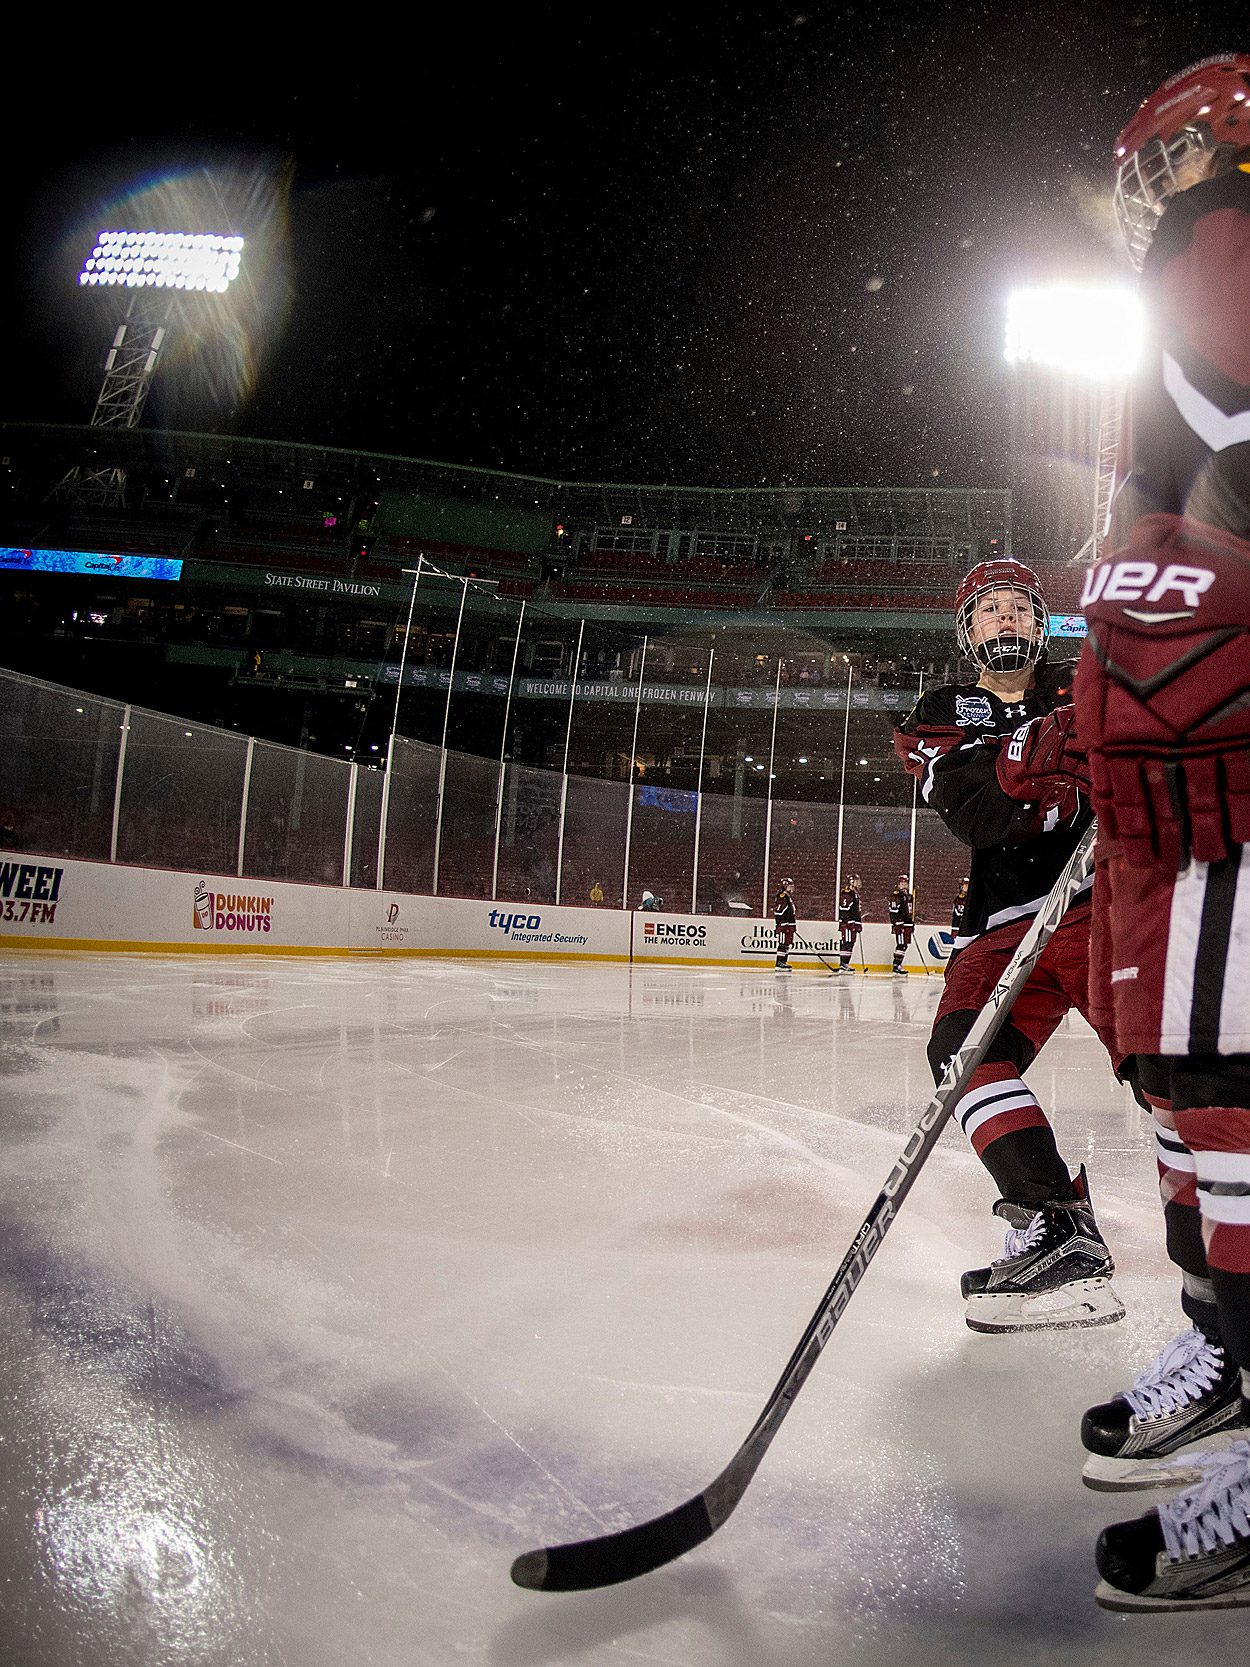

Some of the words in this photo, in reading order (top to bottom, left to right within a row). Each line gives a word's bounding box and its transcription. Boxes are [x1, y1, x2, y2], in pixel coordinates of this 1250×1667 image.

[264, 573, 293, 586] STATE
[294, 576, 331, 591] STREET
[332, 580, 381, 596] PAVILION
[526, 683, 568, 696] WELCOME
[583, 685, 620, 697] CAPITAL
[622, 687, 640, 698] ONE
[642, 688, 677, 700] FROZEN
[679, 690, 716, 702] FENWAY
[0, 861, 64, 901] WEEI
[215, 893, 275, 914] DUNKIN'
[215, 912, 271, 932] DONUTS
[488, 909, 543, 934] tyco
[655, 923, 707, 938] ENEOS
[381, 933, 404, 942] CASINO
[511, 931, 553, 944] Integrated
[553, 933, 589, 946] Security
[643, 936, 659, 945] THE
[660, 937, 688, 946] MOTOR
[691, 938, 706, 947] OIL
